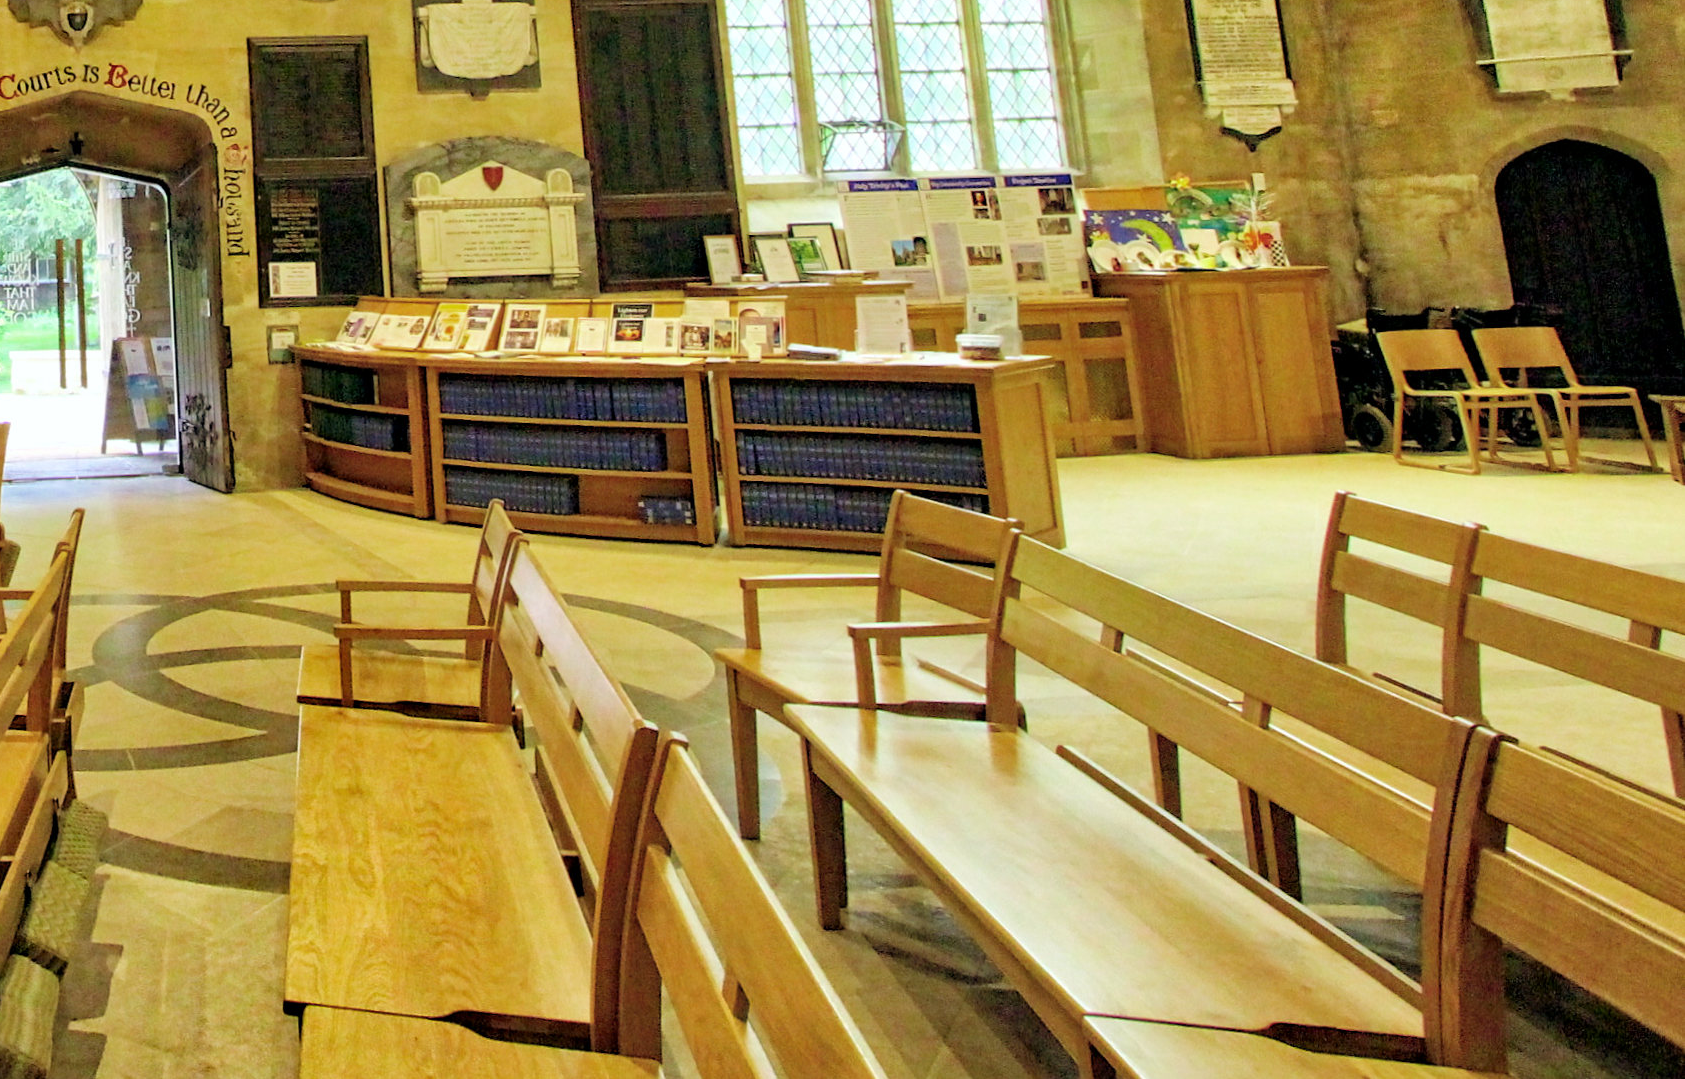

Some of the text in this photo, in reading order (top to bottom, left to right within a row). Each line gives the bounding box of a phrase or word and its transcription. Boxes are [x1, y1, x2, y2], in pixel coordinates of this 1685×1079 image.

[103, 63, 176, 100] Better
[186, 83, 231, 125] than
[220, 126, 238, 140] a
[223, 143, 251, 258] Thousand
